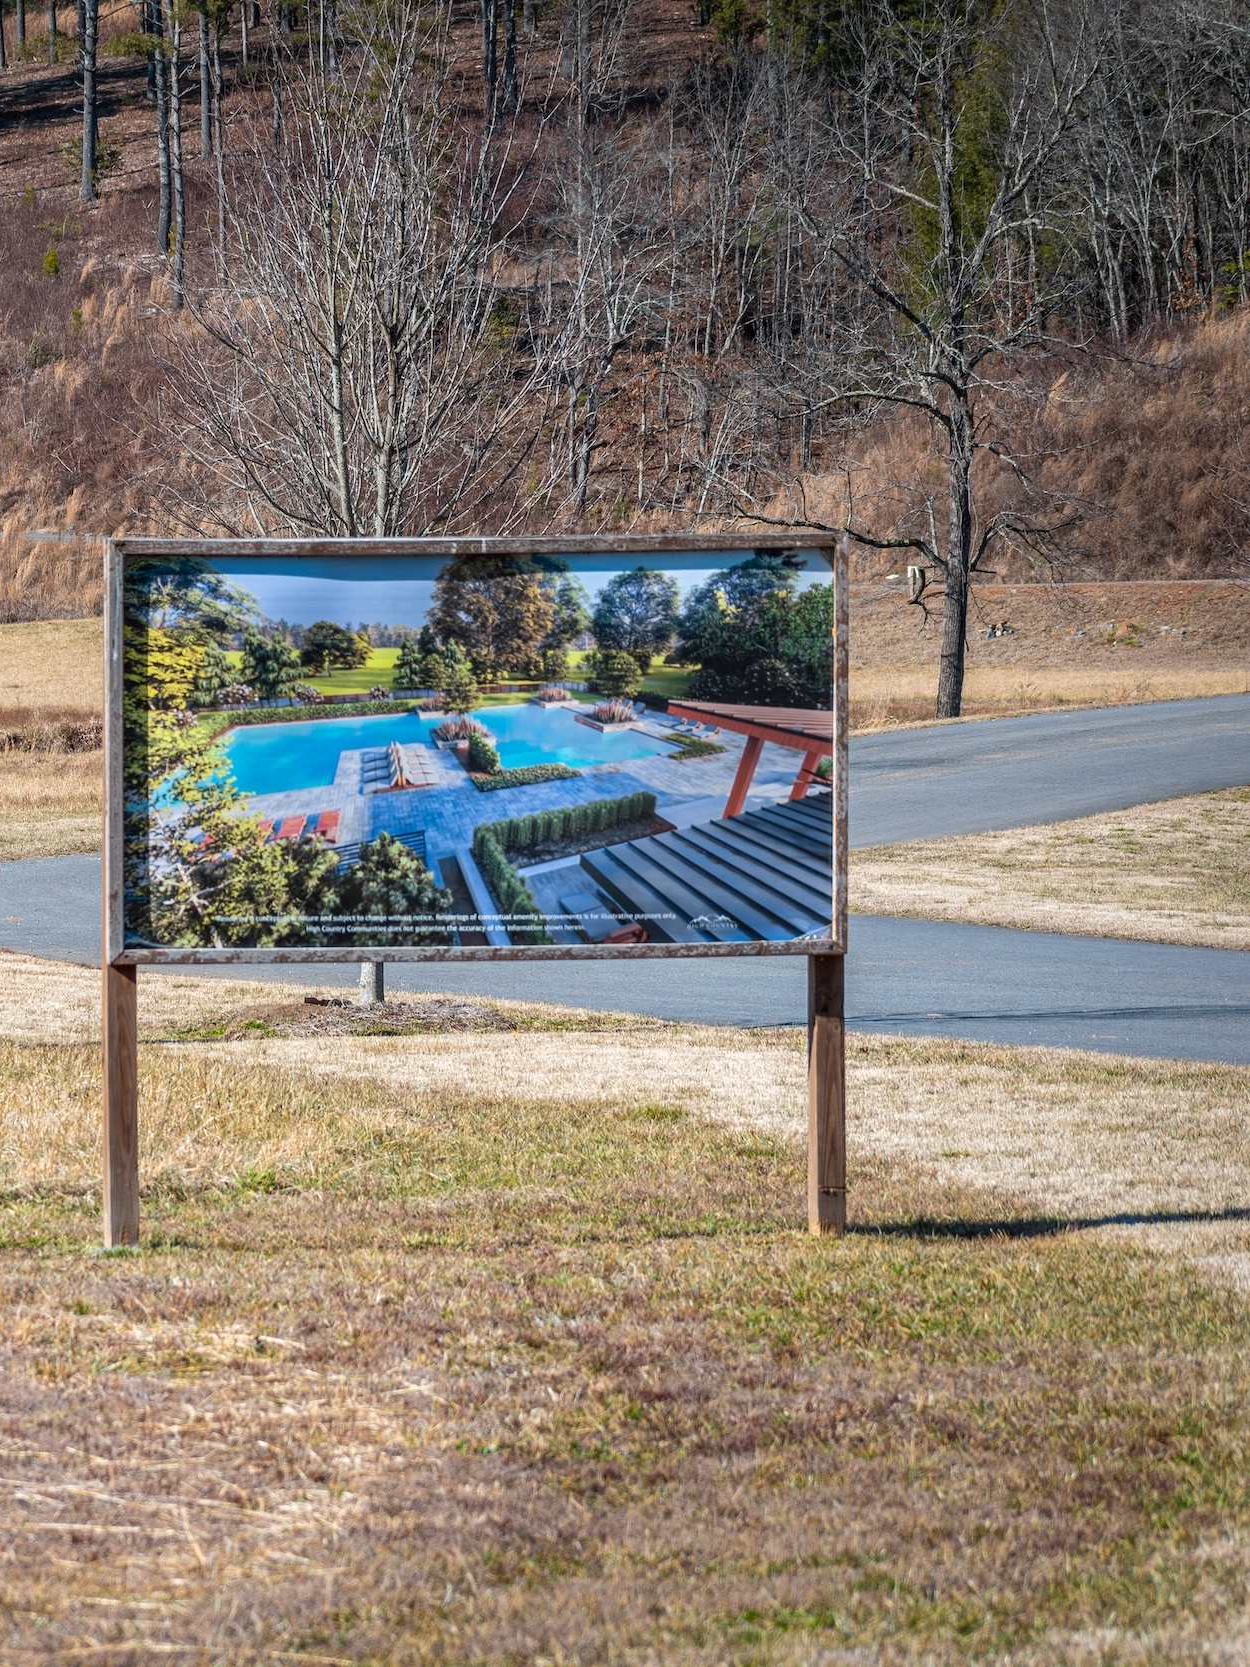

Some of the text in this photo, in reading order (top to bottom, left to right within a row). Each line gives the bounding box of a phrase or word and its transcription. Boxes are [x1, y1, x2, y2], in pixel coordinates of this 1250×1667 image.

[333, 914, 355, 922] subject
[365, 914, 387, 922] change
[435, 913, 469, 922] Renderings
[478, 913, 512, 921] conceptual
[513, 913, 538, 921] amenity
[539, 913, 582, 921] improvements
[600, 912, 633, 920] illustrative
[634, 912, 661, 921] purposes
[306, 925, 321, 934] High
[321, 925, 346, 933] Country
[414, 925, 446, 933] guarantee
